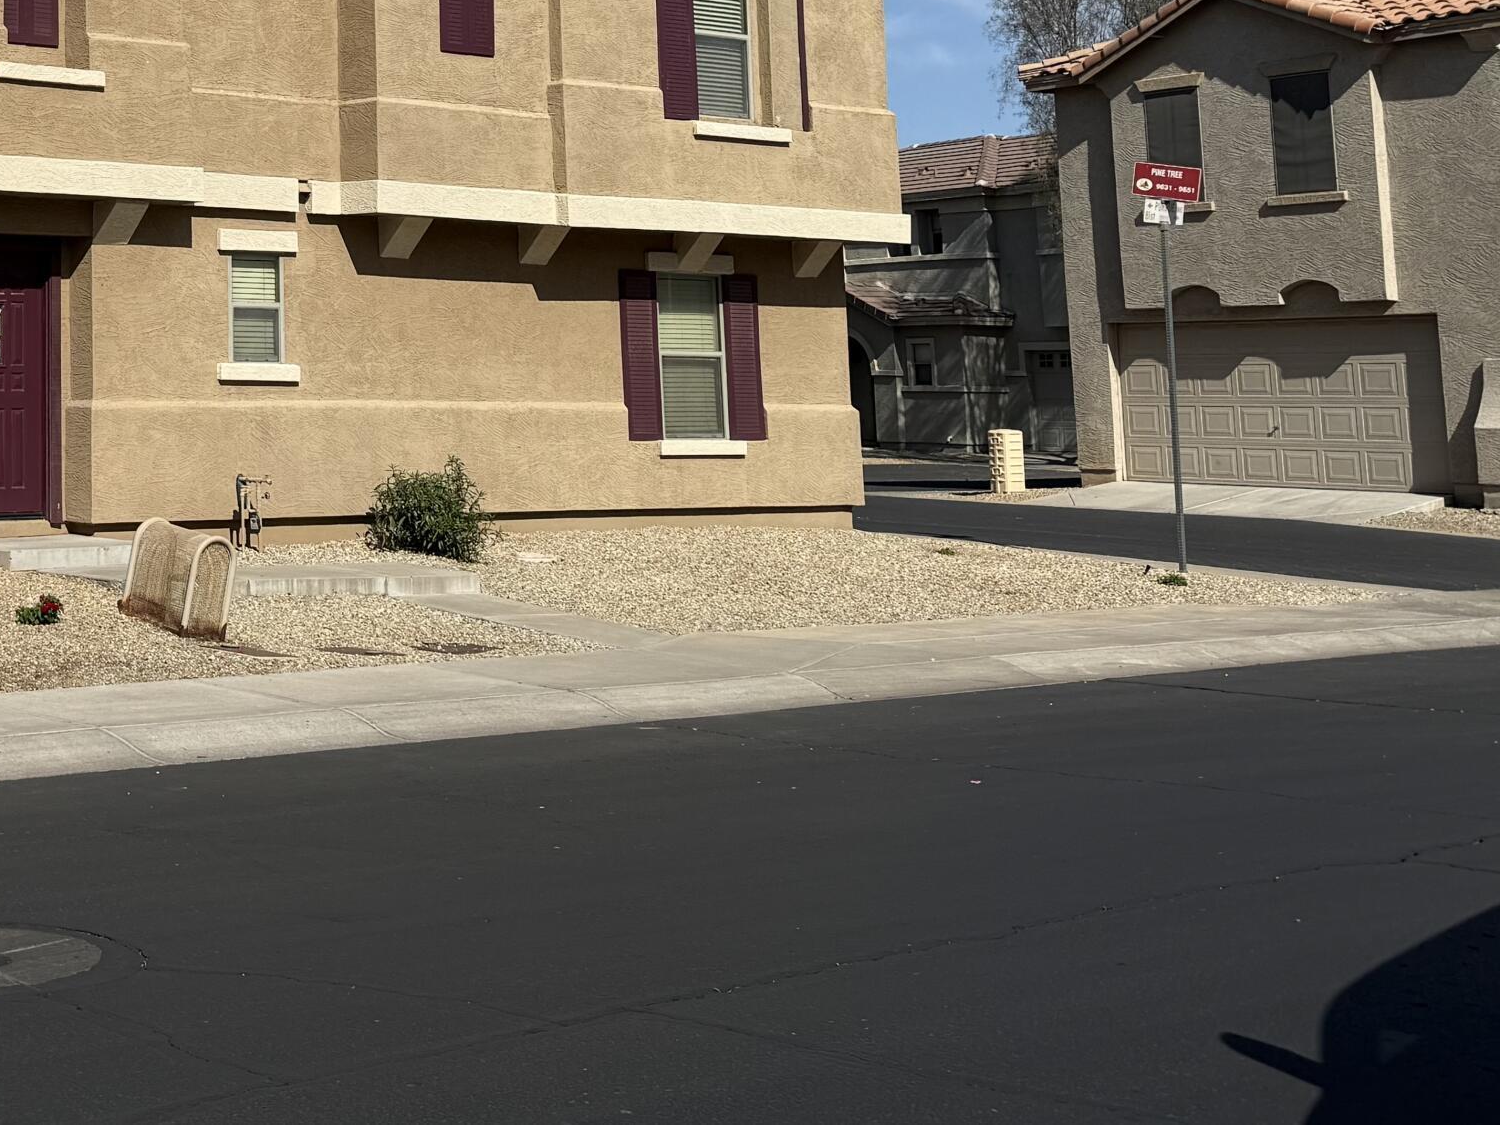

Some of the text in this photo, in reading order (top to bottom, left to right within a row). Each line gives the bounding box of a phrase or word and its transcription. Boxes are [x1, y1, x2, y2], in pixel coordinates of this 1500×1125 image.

[1151, 168, 1183, 179] PINE TREE
[1156, 183, 1172, 191] 9631
